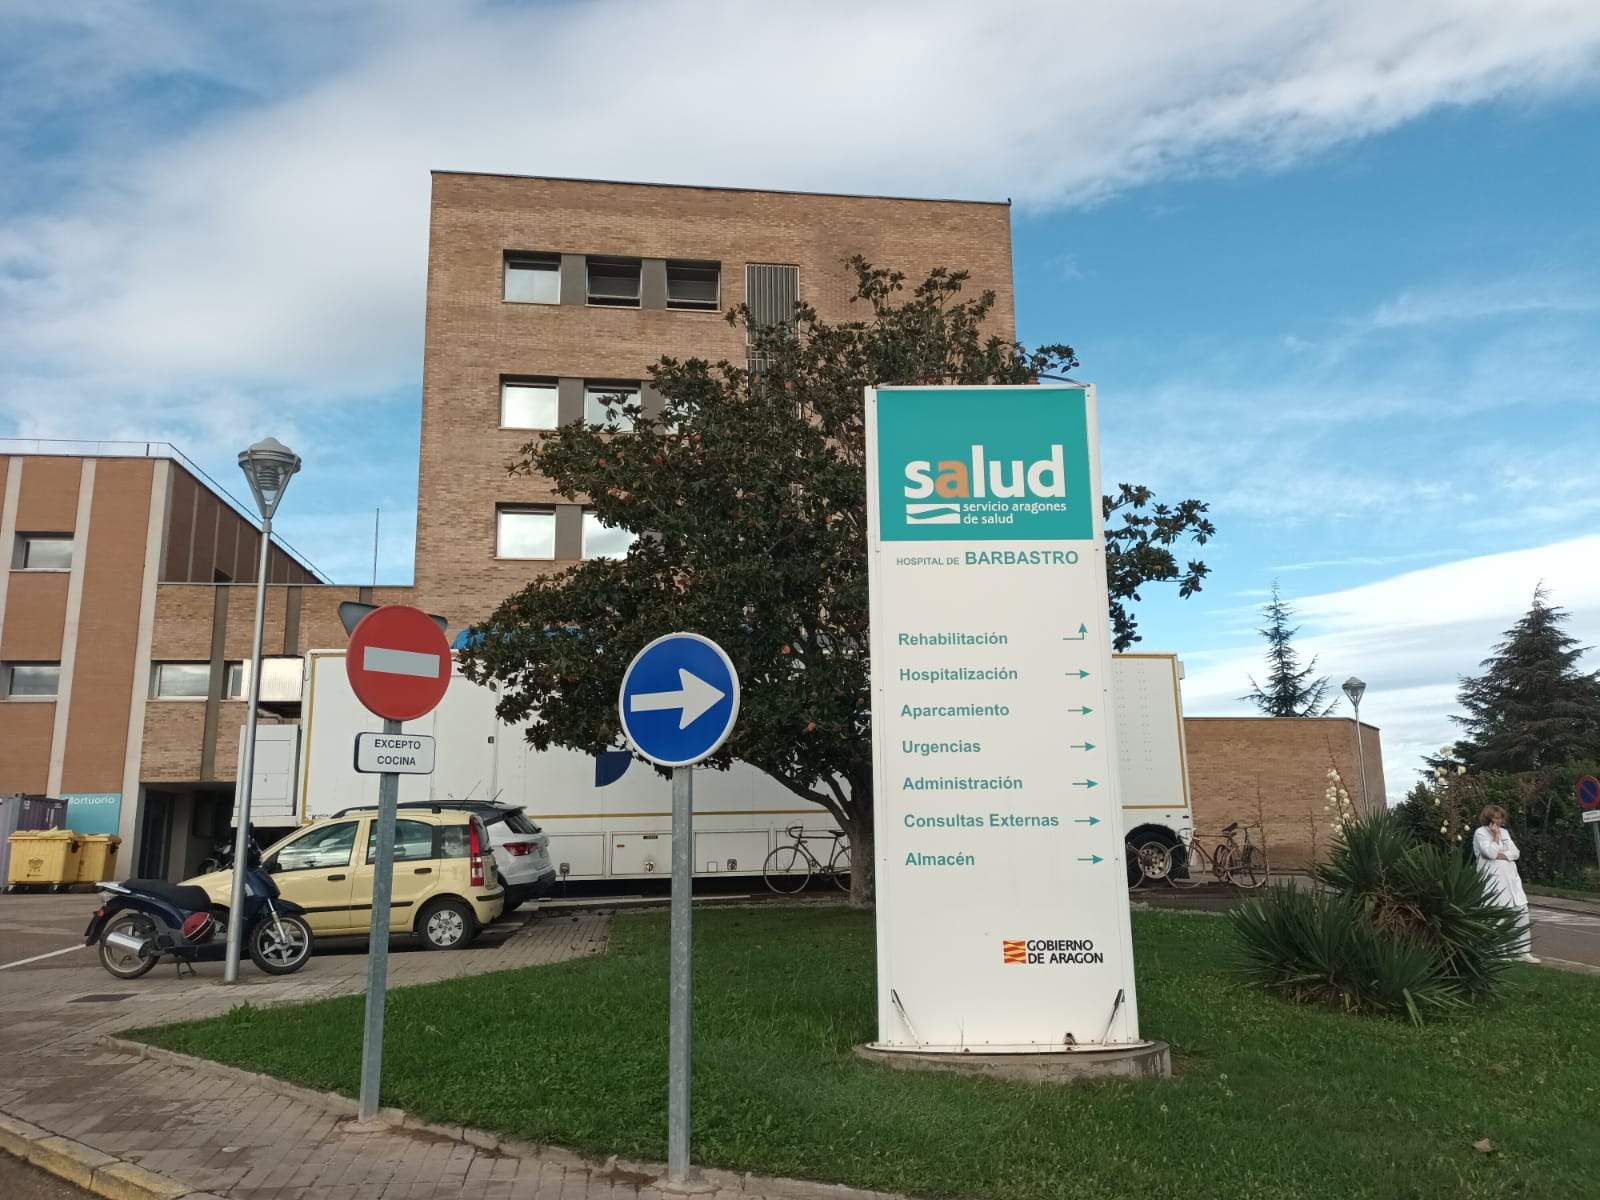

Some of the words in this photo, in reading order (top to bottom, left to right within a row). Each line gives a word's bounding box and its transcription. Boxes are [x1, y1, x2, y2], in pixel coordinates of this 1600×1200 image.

[904, 444, 1066, 499] salud
[963, 501, 1009, 512] servicio
[1012, 501, 1067, 515] aragones
[963, 513, 979, 524] de
[982, 513, 1014, 524] salud
[896, 557, 944, 566] HOSPITAL
[946, 557, 960, 566] DE
[965, 550, 1079, 565] BARBASTRO
[898, 632, 1008, 646] Rehabilitación
[899, 667, 1018, 683] Hospitalización
[901, 703, 1010, 719] Aparcamiento
[374, 739, 421, 750] EXCEPTO
[902, 739, 981, 756] Urgencias
[377, 755, 416, 766] COCINA
[902, 775, 1023, 791] Administración
[904, 814, 984, 828] Consultas
[989, 813, 1059, 827] Externas
[905, 851, 975, 866] Almacén
[1026, 939, 1094, 951] GOBIERNO
[1028, 952, 1045, 964] DE
[1049, 952, 1104, 964] ARAGON
